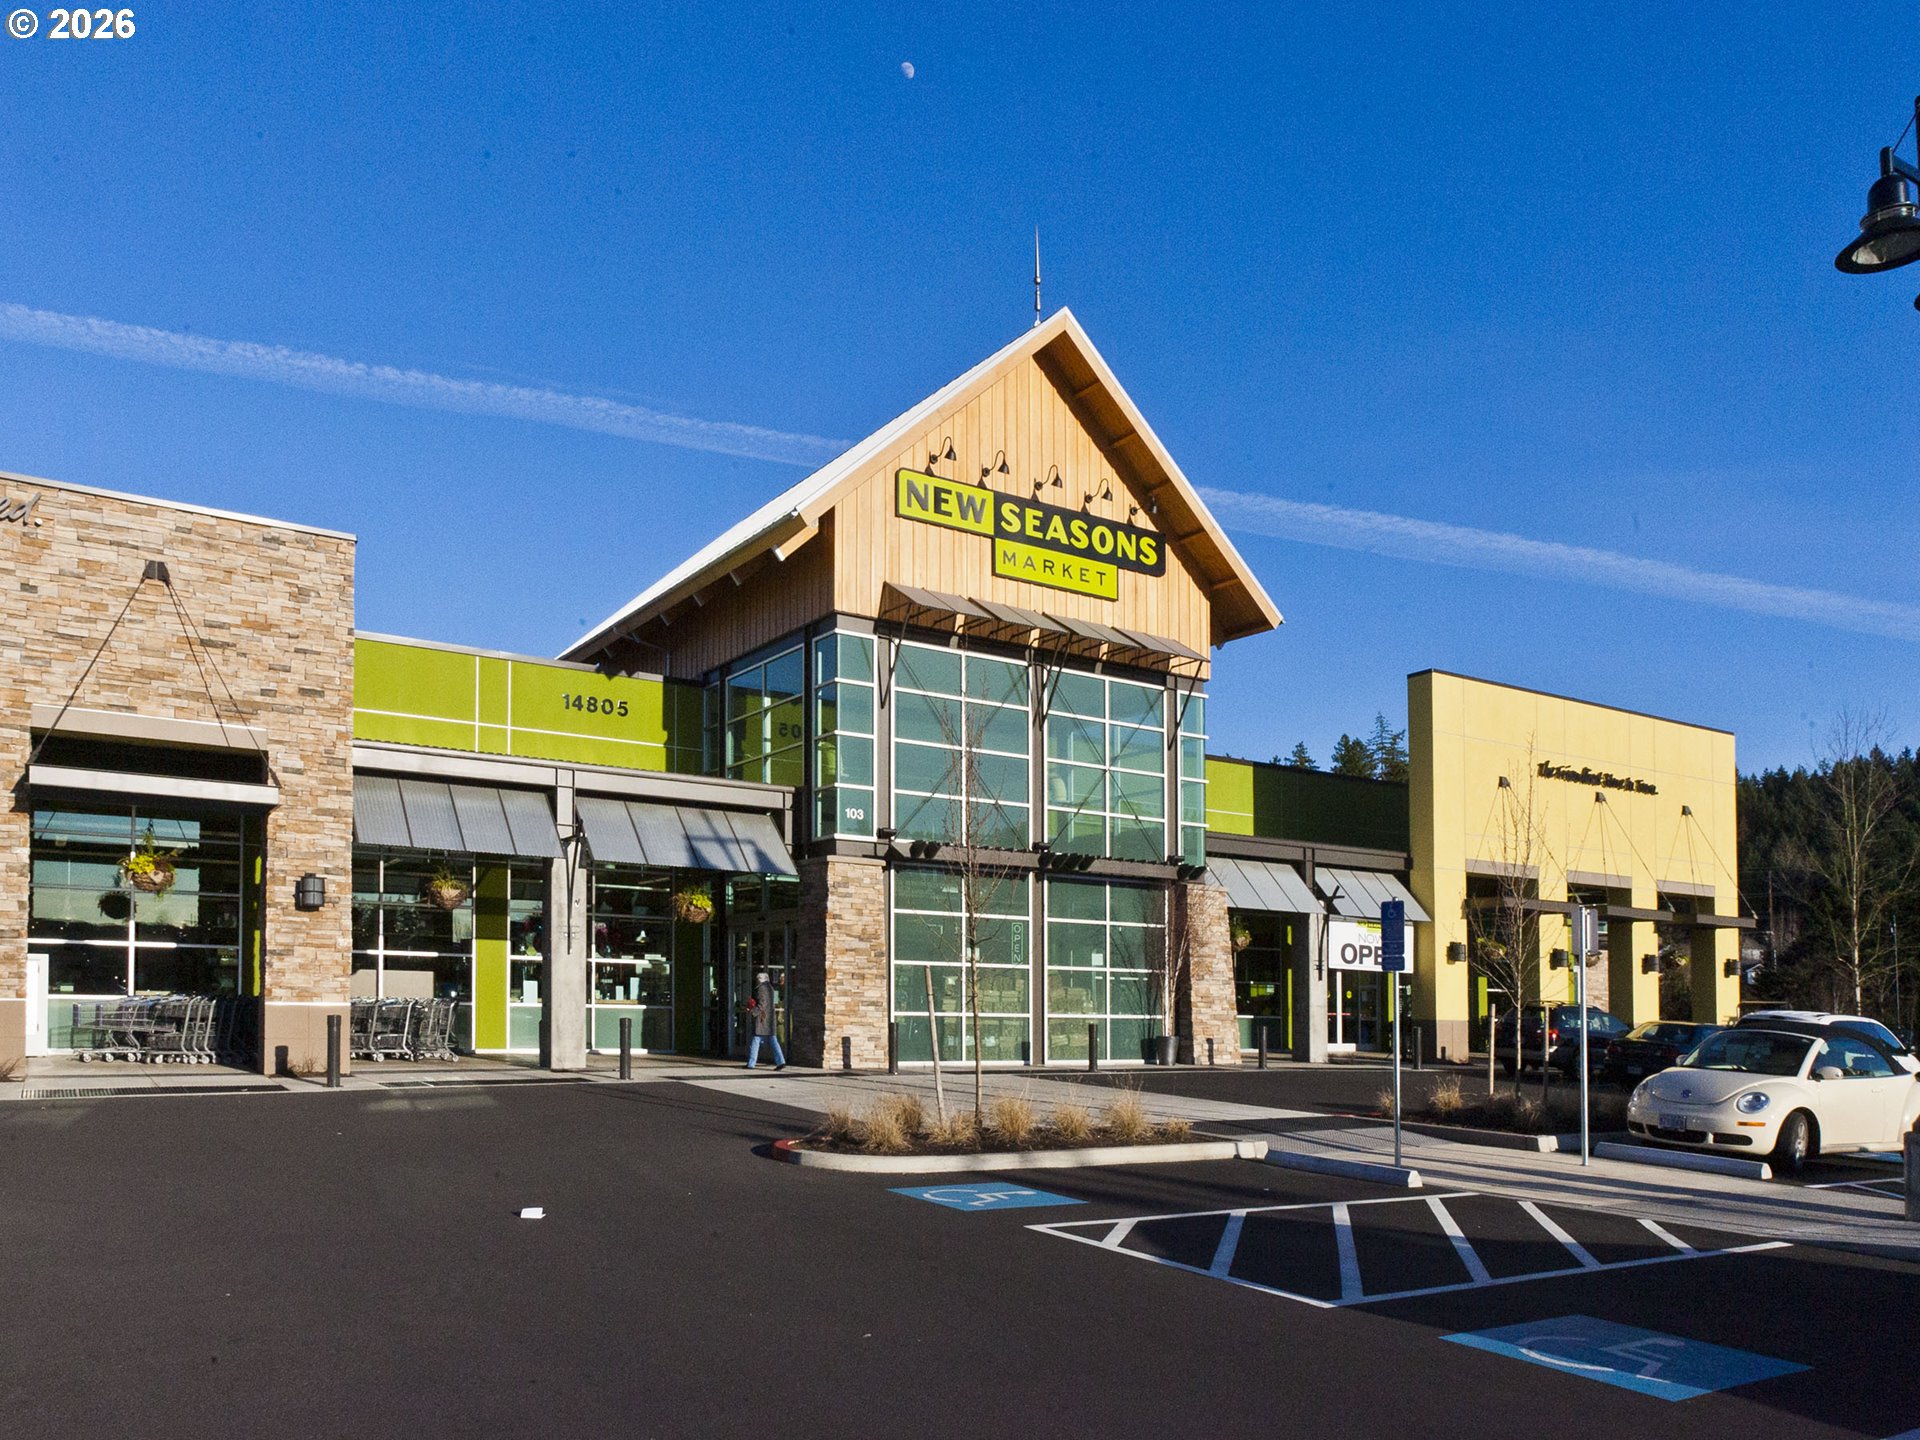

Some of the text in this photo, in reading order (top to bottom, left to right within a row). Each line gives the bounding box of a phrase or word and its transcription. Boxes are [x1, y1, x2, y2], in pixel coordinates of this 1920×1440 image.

[906, 479, 1158, 566] NEW SEASONS
[1003, 550, 1106, 586] MARKET
[562, 694, 628, 717] 14805
[845, 808, 864, 820] 103
[1013, 924, 1021, 962] OPEN
[1341, 943, 1382, 965] OPE
